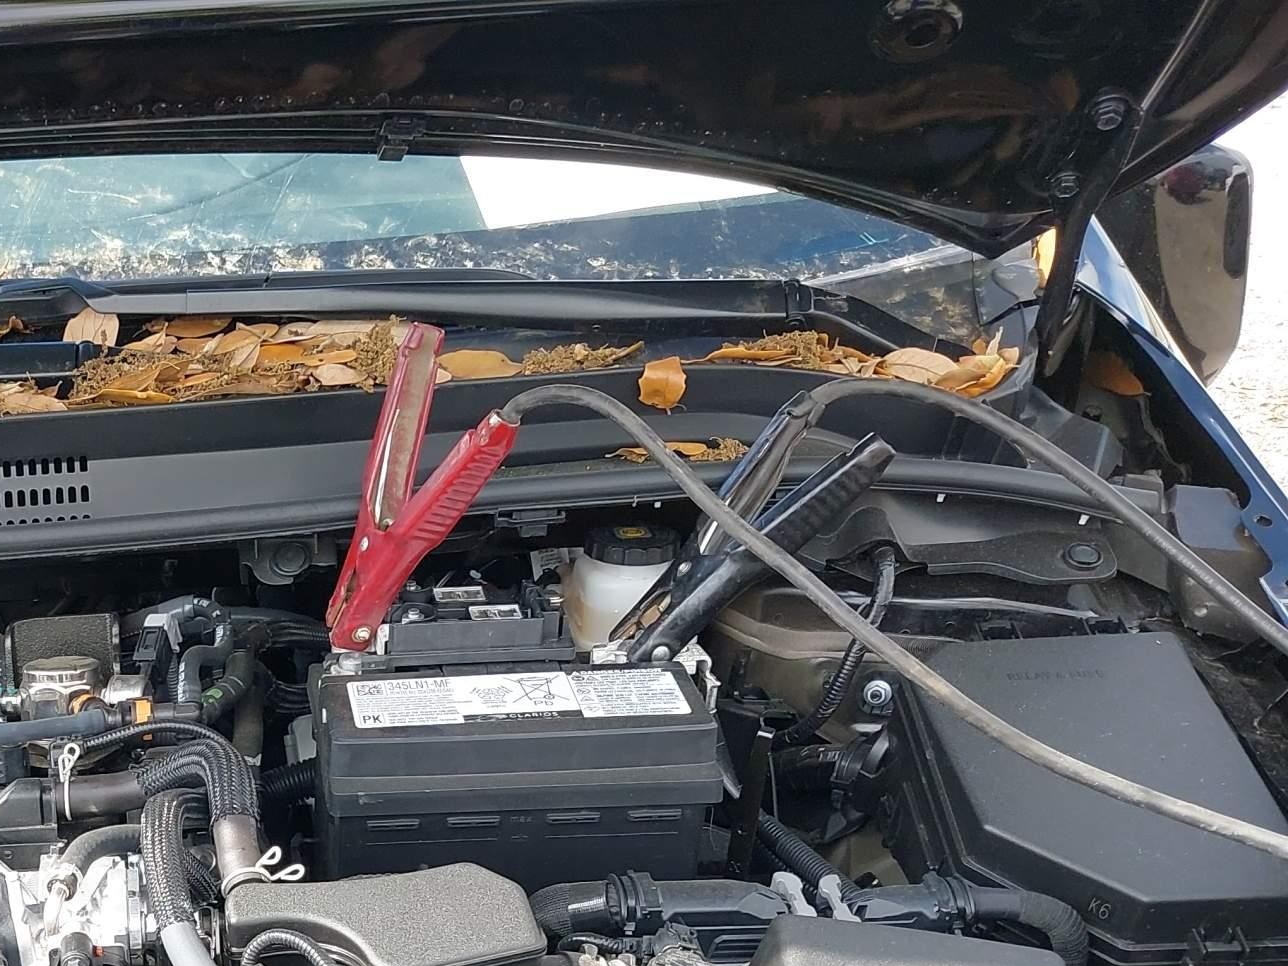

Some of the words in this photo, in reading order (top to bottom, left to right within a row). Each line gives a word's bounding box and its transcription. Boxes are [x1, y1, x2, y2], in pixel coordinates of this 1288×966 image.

[388, 679, 452, 691] 345LN1-MF
[362, 714, 383, 724] PK
[509, 711, 559, 719] CLARIOS
[1087, 897, 1111, 920] K6
